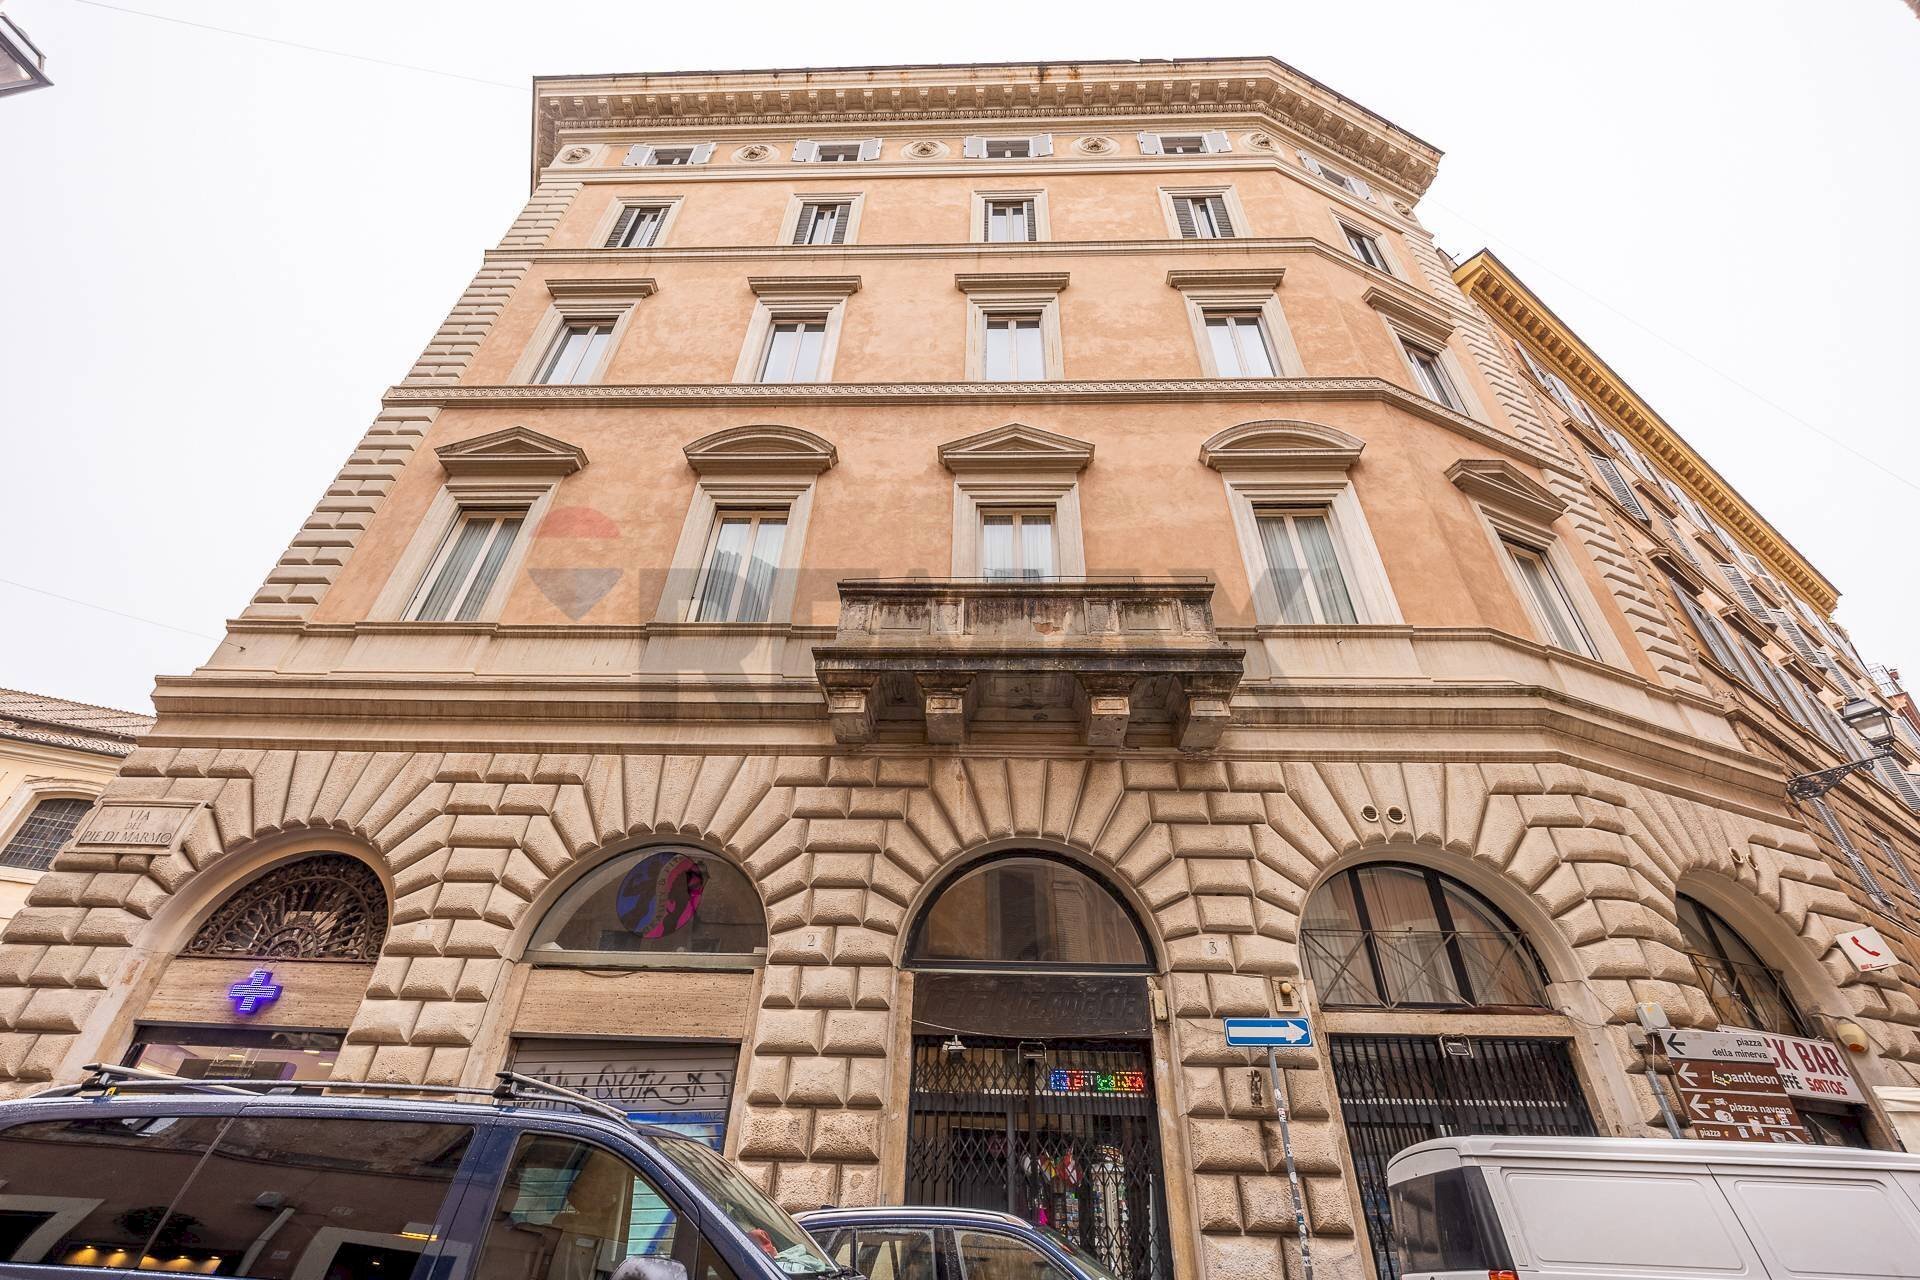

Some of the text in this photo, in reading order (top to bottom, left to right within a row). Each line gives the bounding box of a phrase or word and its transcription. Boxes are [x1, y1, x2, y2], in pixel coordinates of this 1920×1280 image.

[130, 809, 151, 821] VIA
[124, 822, 142, 830] DEL
[80, 830, 173, 844] PIE DI MARMO
[807, 934, 816, 947] 2
[1208, 941, 1218, 955] 3
[1736, 1038, 1763, 1047] piazza
[1712, 1048, 1768, 1059] della minerva
[1792, 1042, 1849, 1077] BAR
[1805, 1077, 1848, 1096] SANTOS
[1728, 1102, 1793, 1116] piazza navona
[1699, 1127, 1721, 1138] piazza
